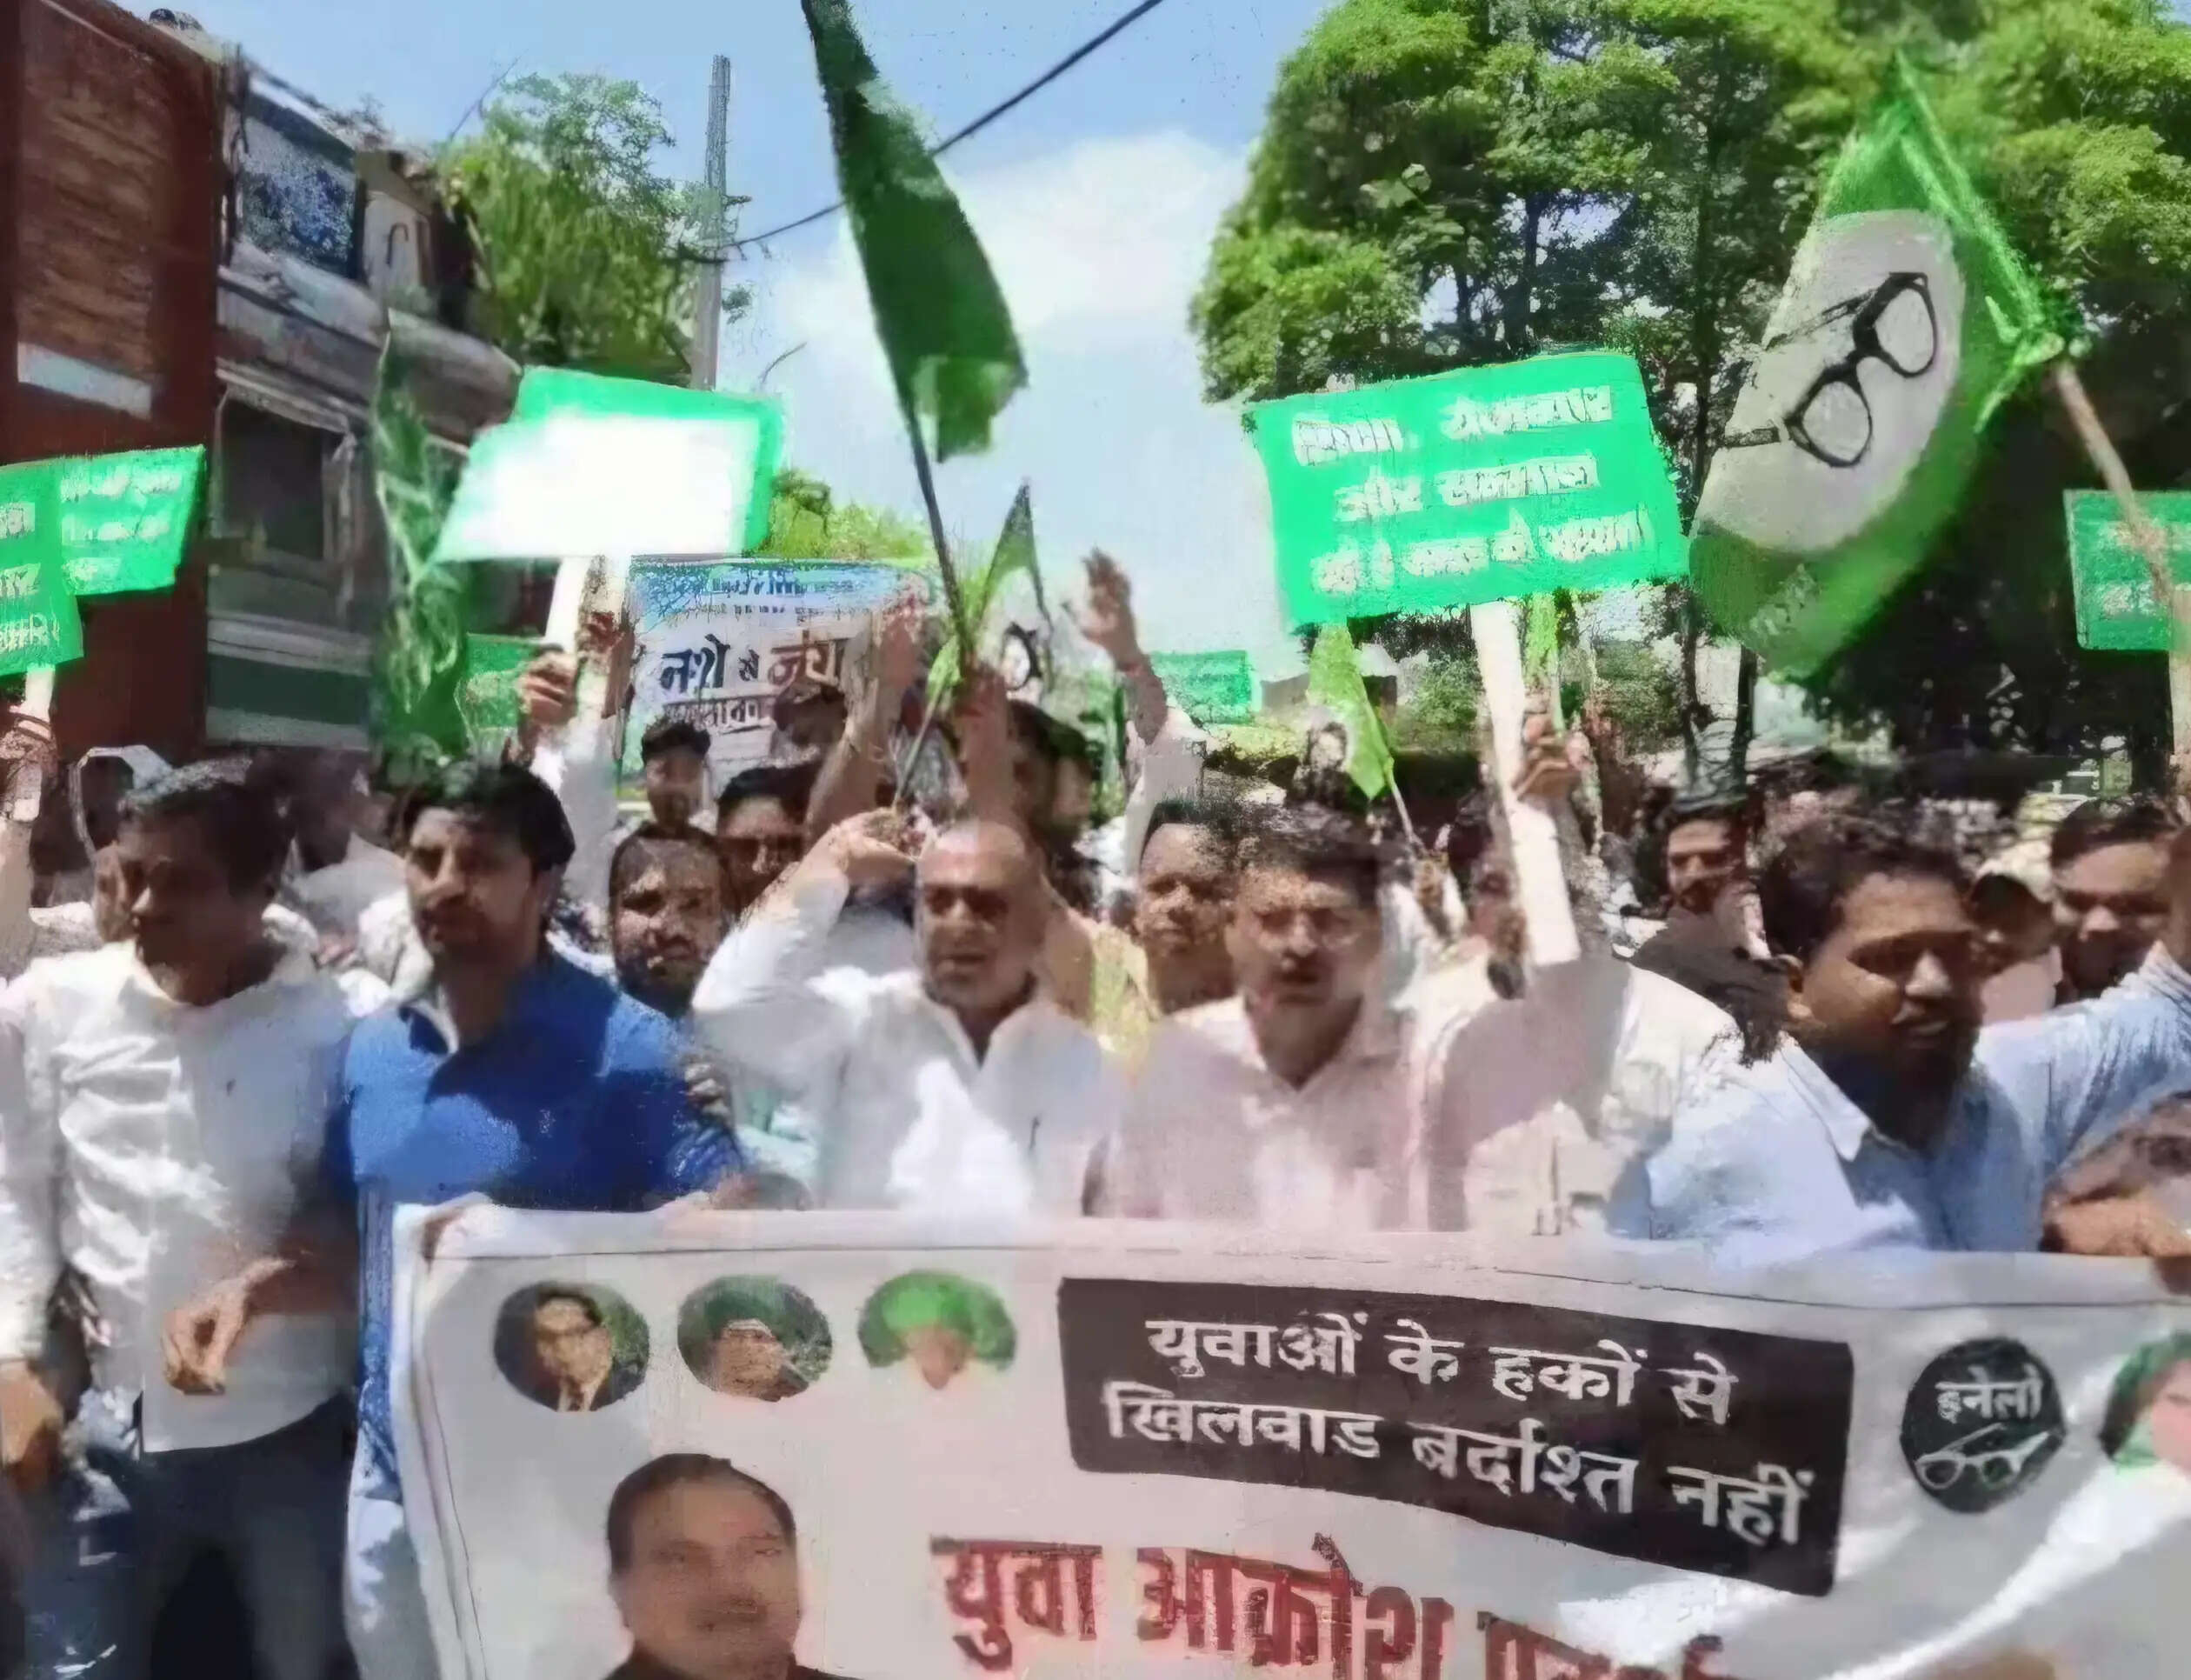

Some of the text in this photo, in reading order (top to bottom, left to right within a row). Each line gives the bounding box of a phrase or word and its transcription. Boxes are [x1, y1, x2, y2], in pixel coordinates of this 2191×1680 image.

[1144, 1310, 1740, 1425] युवाओं के हकों से
[1935, 1363, 2043, 1423] इनेलो
[1405, 1417, 1640, 1514] बर्दाश्त
[1666, 1461, 1815, 1545] नहीं
[929, 1535, 1102, 1671] युवा
